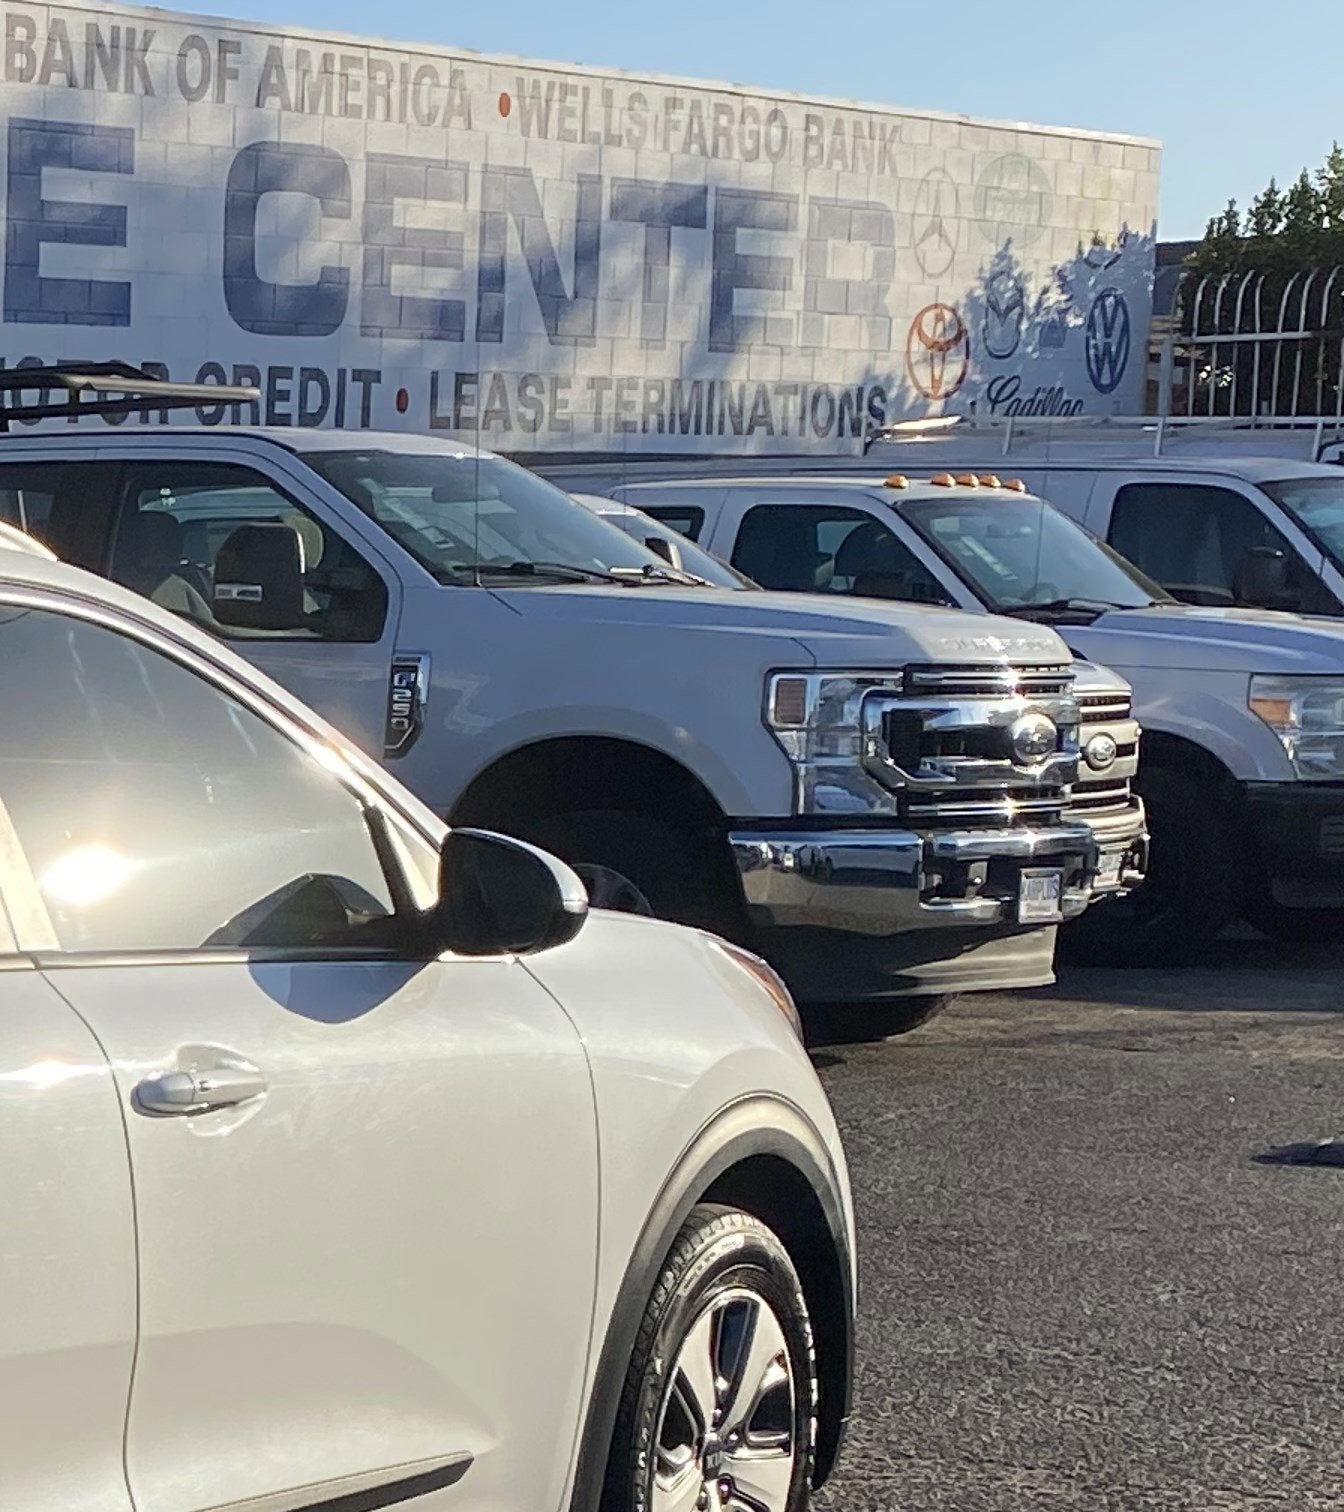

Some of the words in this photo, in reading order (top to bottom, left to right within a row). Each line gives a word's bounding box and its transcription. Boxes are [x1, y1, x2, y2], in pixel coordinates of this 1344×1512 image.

[5, 13, 158, 98] BANK
[177, 34, 242, 105] OF
[256, 45, 473, 131] AMERICA
[516, 77, 650, 147] WELLS
[664, 95, 790, 160] FARGO
[803, 115, 904, 177] BANK
[223, 141, 898, 358] CENTER
[194, 361, 382, 429] CREDIT
[430, 371, 571, 433] LEASE
[590, 376, 886, 440] TERMINATIONS
[987, 374, 1086, 417] Cadillac
